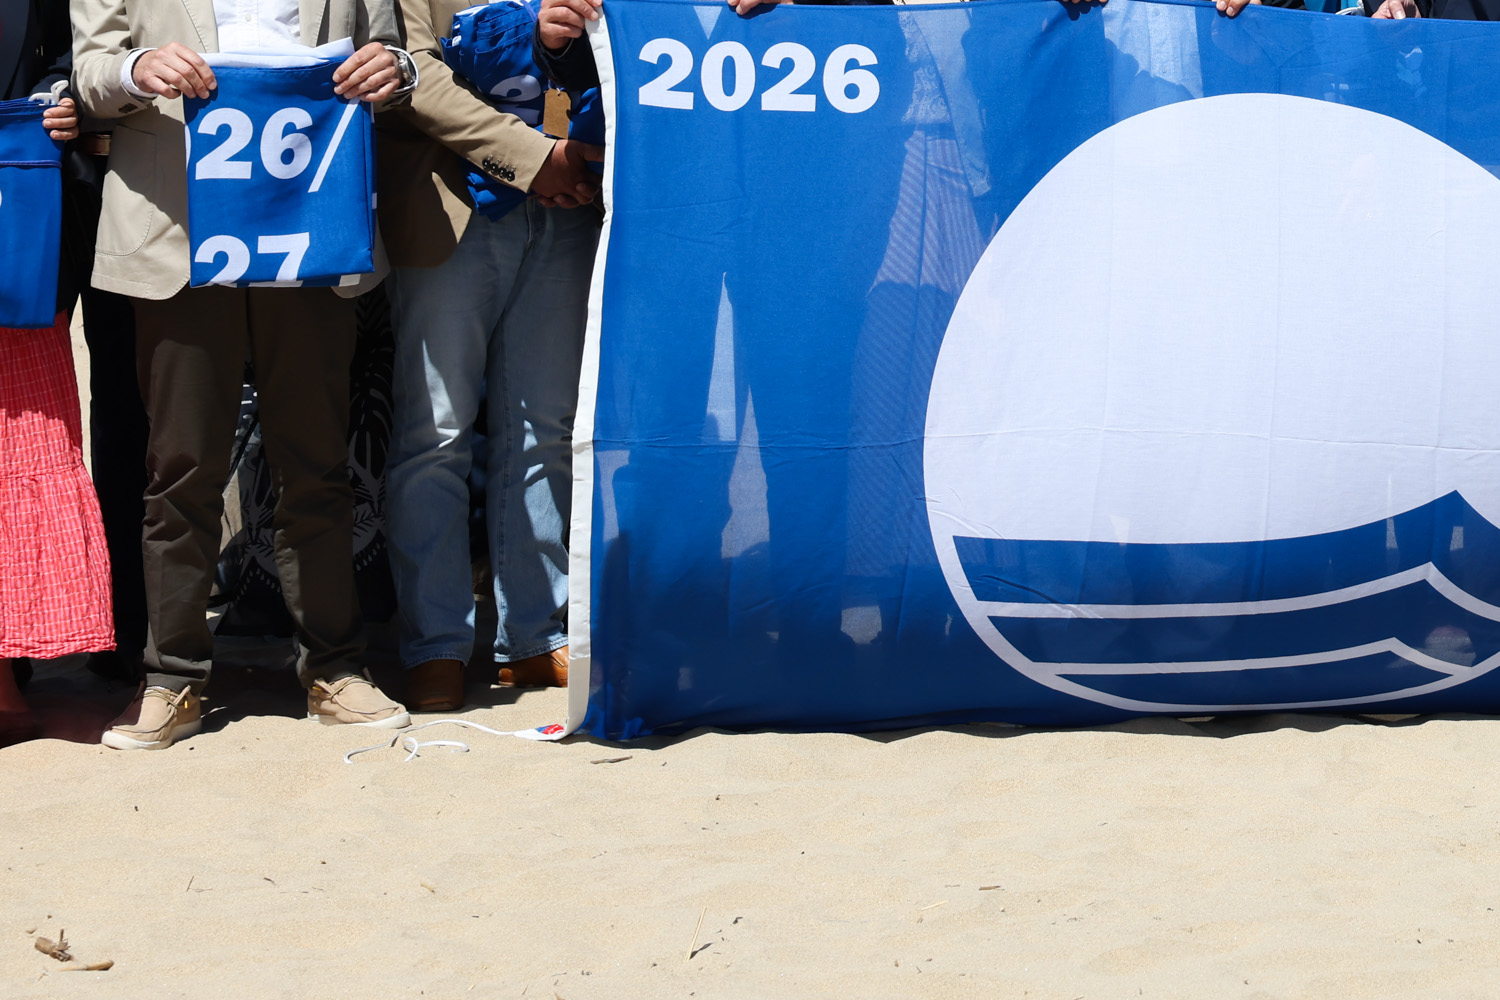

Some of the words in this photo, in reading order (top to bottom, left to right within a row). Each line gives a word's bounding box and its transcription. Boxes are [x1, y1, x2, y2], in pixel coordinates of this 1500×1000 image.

[638, 37, 880, 114] 2026
[184, 97, 361, 193] 26/
[194, 231, 311, 288] 27
